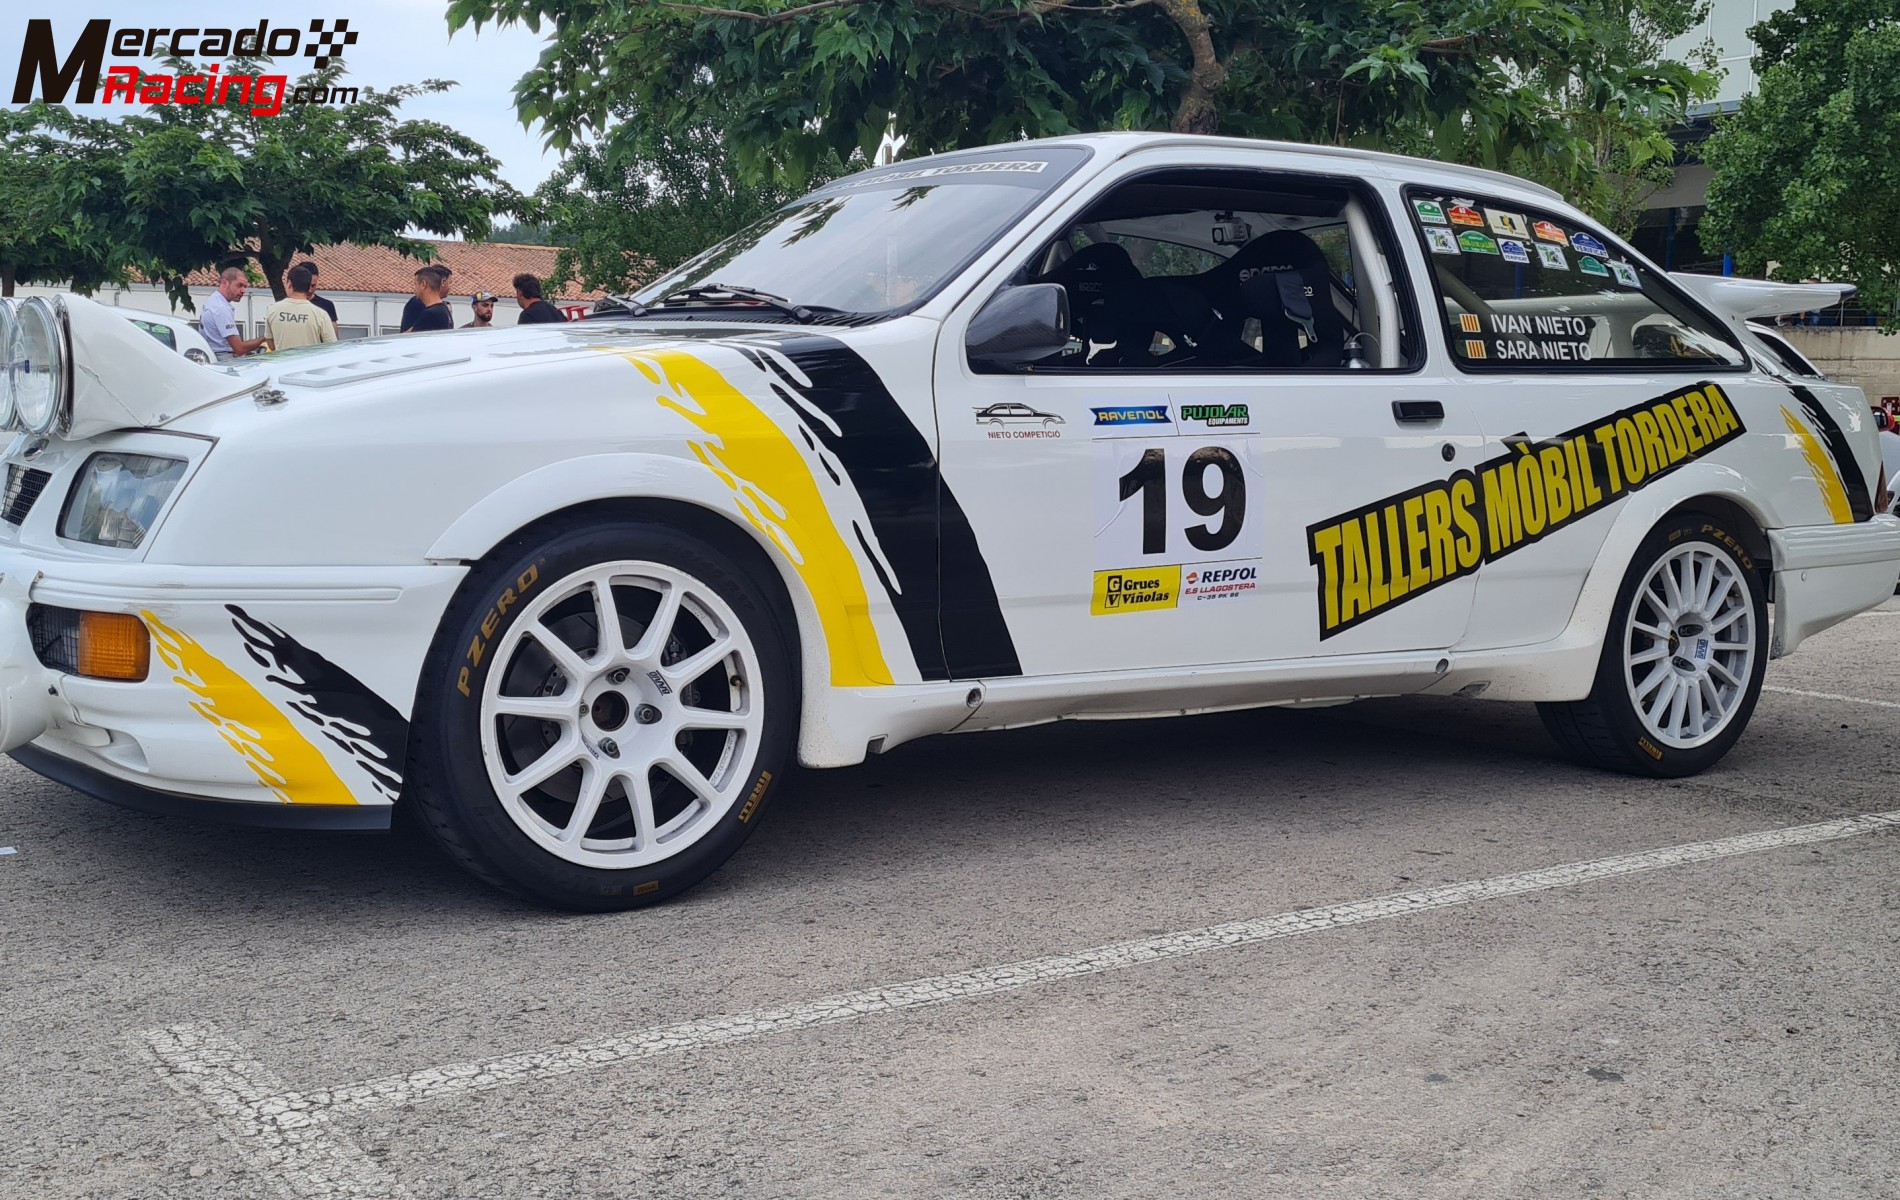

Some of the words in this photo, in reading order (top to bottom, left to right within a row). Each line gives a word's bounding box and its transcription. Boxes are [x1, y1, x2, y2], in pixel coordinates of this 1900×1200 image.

[933, 161, 1044, 175] TORDERA
[1575, 244, 1607, 256] VERIFICAT
[279, 312, 309, 323] STAFF
[1490, 314, 1532, 334] IVAN
[1535, 316, 1586, 336] NIETO
[1496, 339, 1540, 359] SARA
[1541, 341, 1592, 361] NIETO
[1098, 411, 1164, 421] RAVENOL
[1182, 405, 1248, 419] PUJOLAR
[1208, 417, 1248, 425] EQUIPAMENTS
[1013, 429, 1060, 438] COMPETICIÓ
[1119, 446, 1246, 555] 19
[1314, 479, 1481, 630] TALLERS
[1481, 440, 1602, 554] MÒBIL
[1594, 384, 1739, 493] TORDERA
[1202, 567, 1257, 583] REPSOL
[1109, 577, 1121, 591] G
[1124, 579, 1160, 591] Grues
[1200, 583, 1256, 593] LLAGOSTERA
[1108, 594, 1119, 605] V
[1122, 591, 1169, 604] Viñolas
[738, 770, 773, 823] PIRELLI
